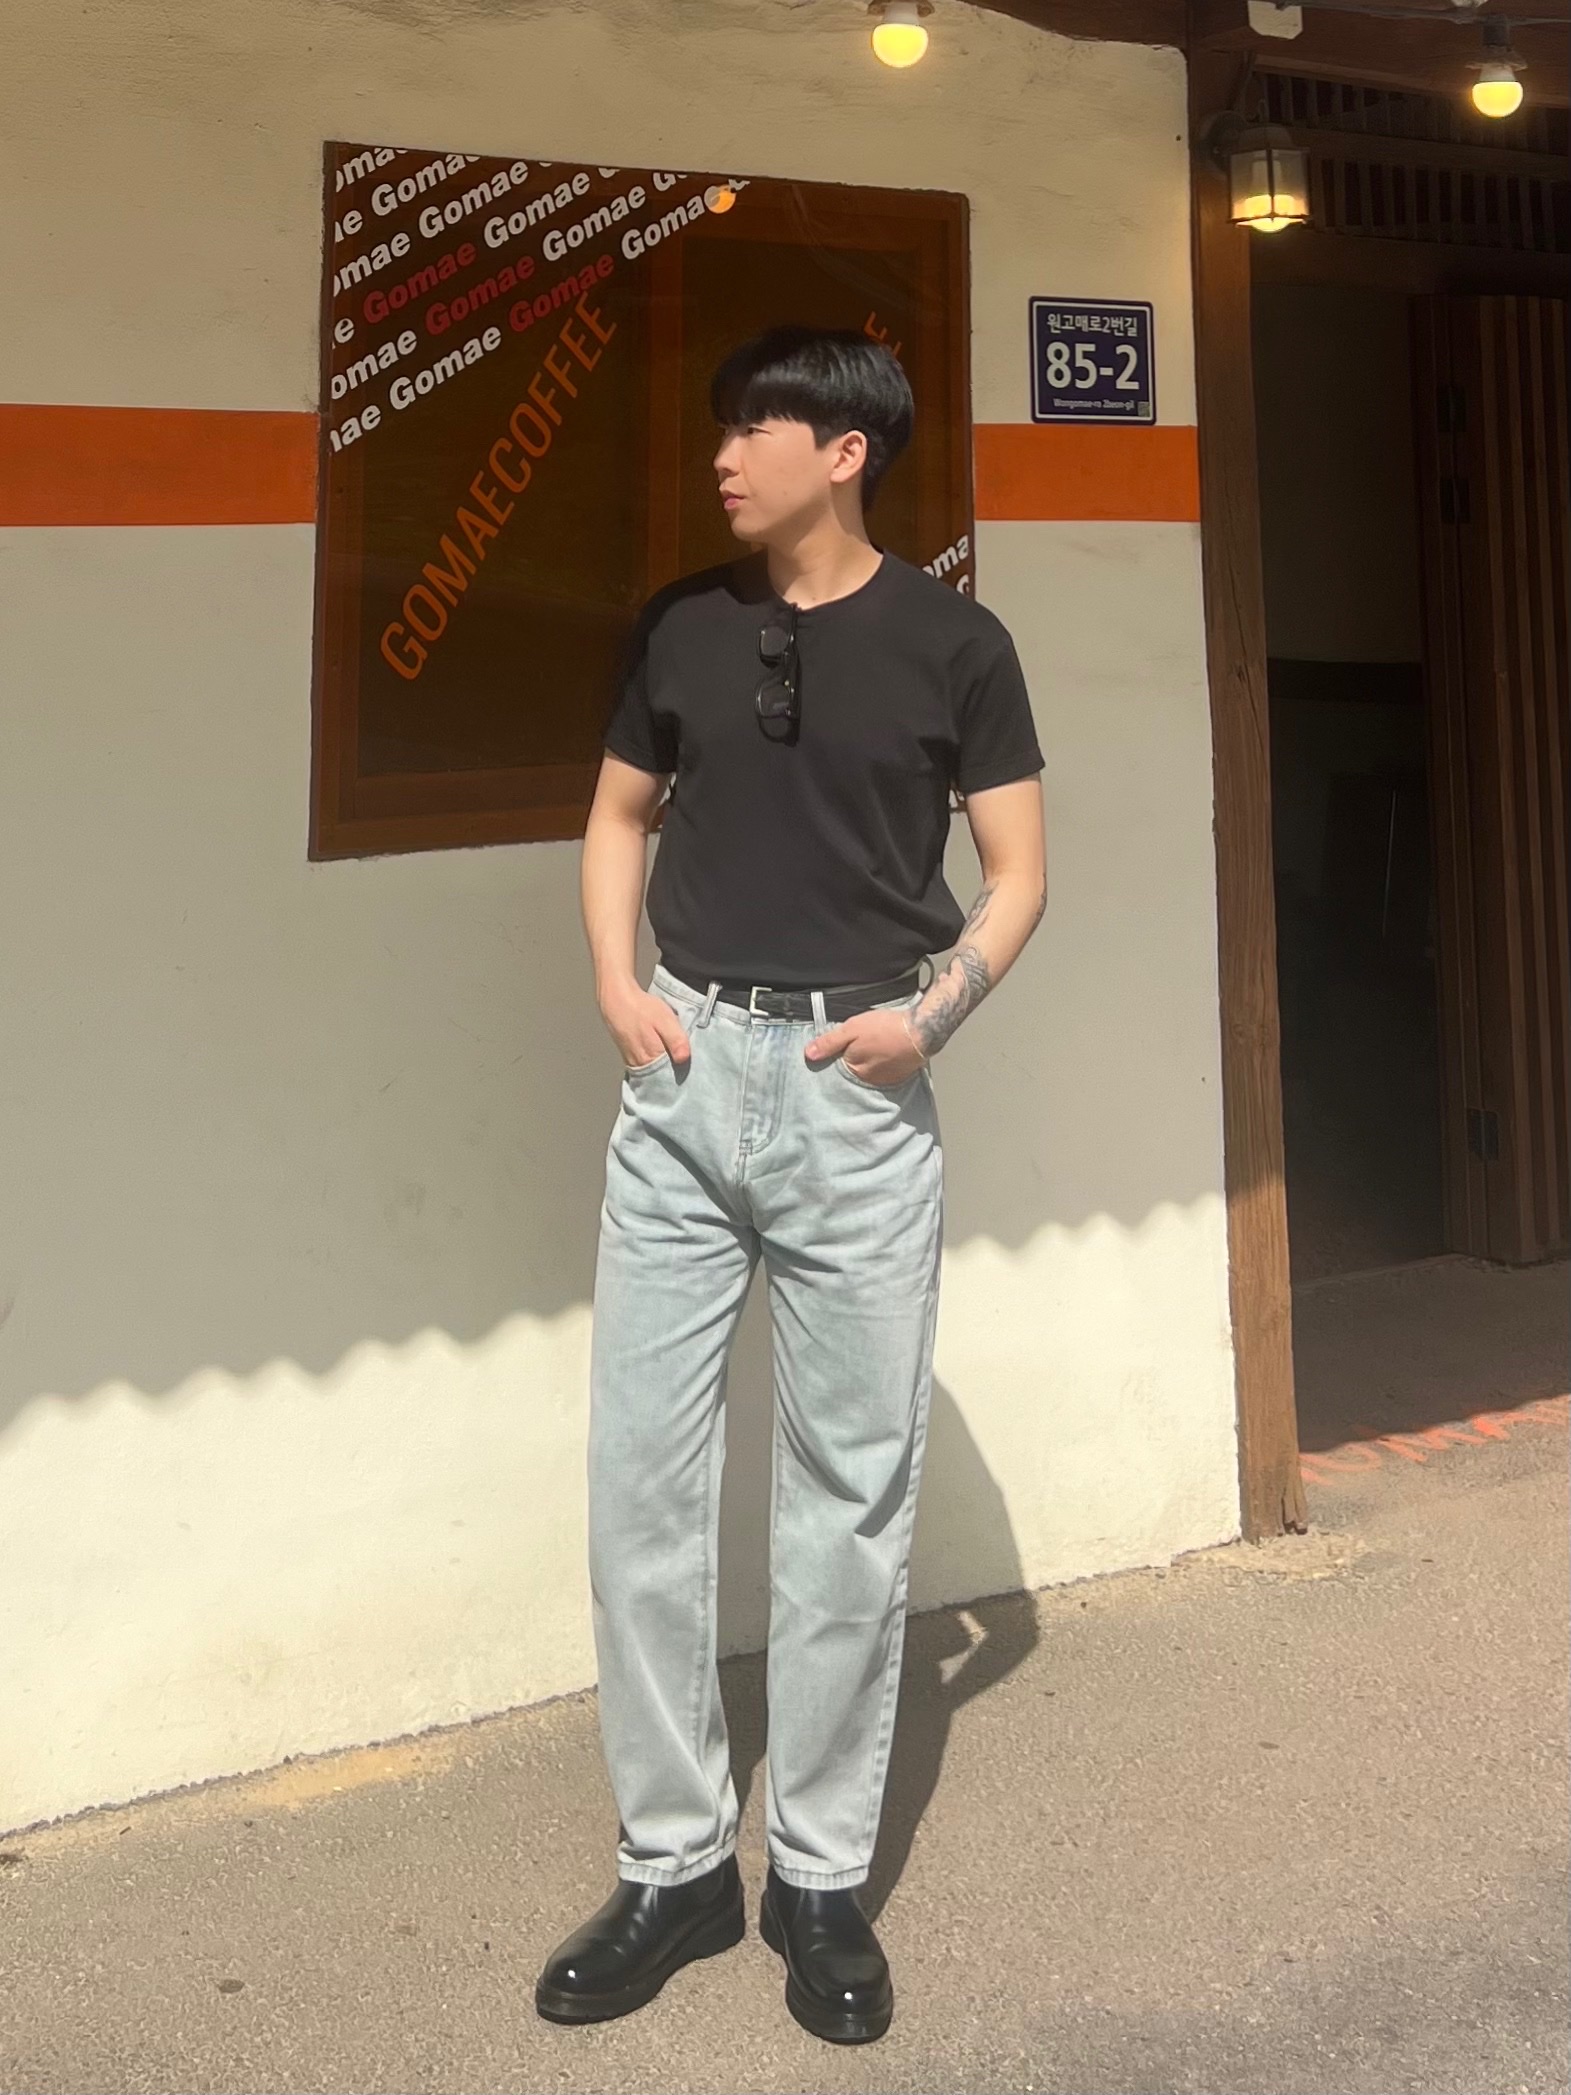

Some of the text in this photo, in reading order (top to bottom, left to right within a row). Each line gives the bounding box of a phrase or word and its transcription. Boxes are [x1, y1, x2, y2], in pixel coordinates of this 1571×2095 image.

[363, 242, 477, 324] Gomae
[484, 172, 590, 248] Gomae
[418, 161, 529, 239] Gomae
[425, 255, 535, 336] Gomae
[542, 186, 646, 261] Gomae
[389, 326, 502, 411] Gomae
[508, 254, 614, 333] Gomae
[1046, 341, 1140, 390] 85-2
[1047, 313, 1138, 337] 원고매로2번길
[380, 292, 617, 681] GOMAECOFFEE
